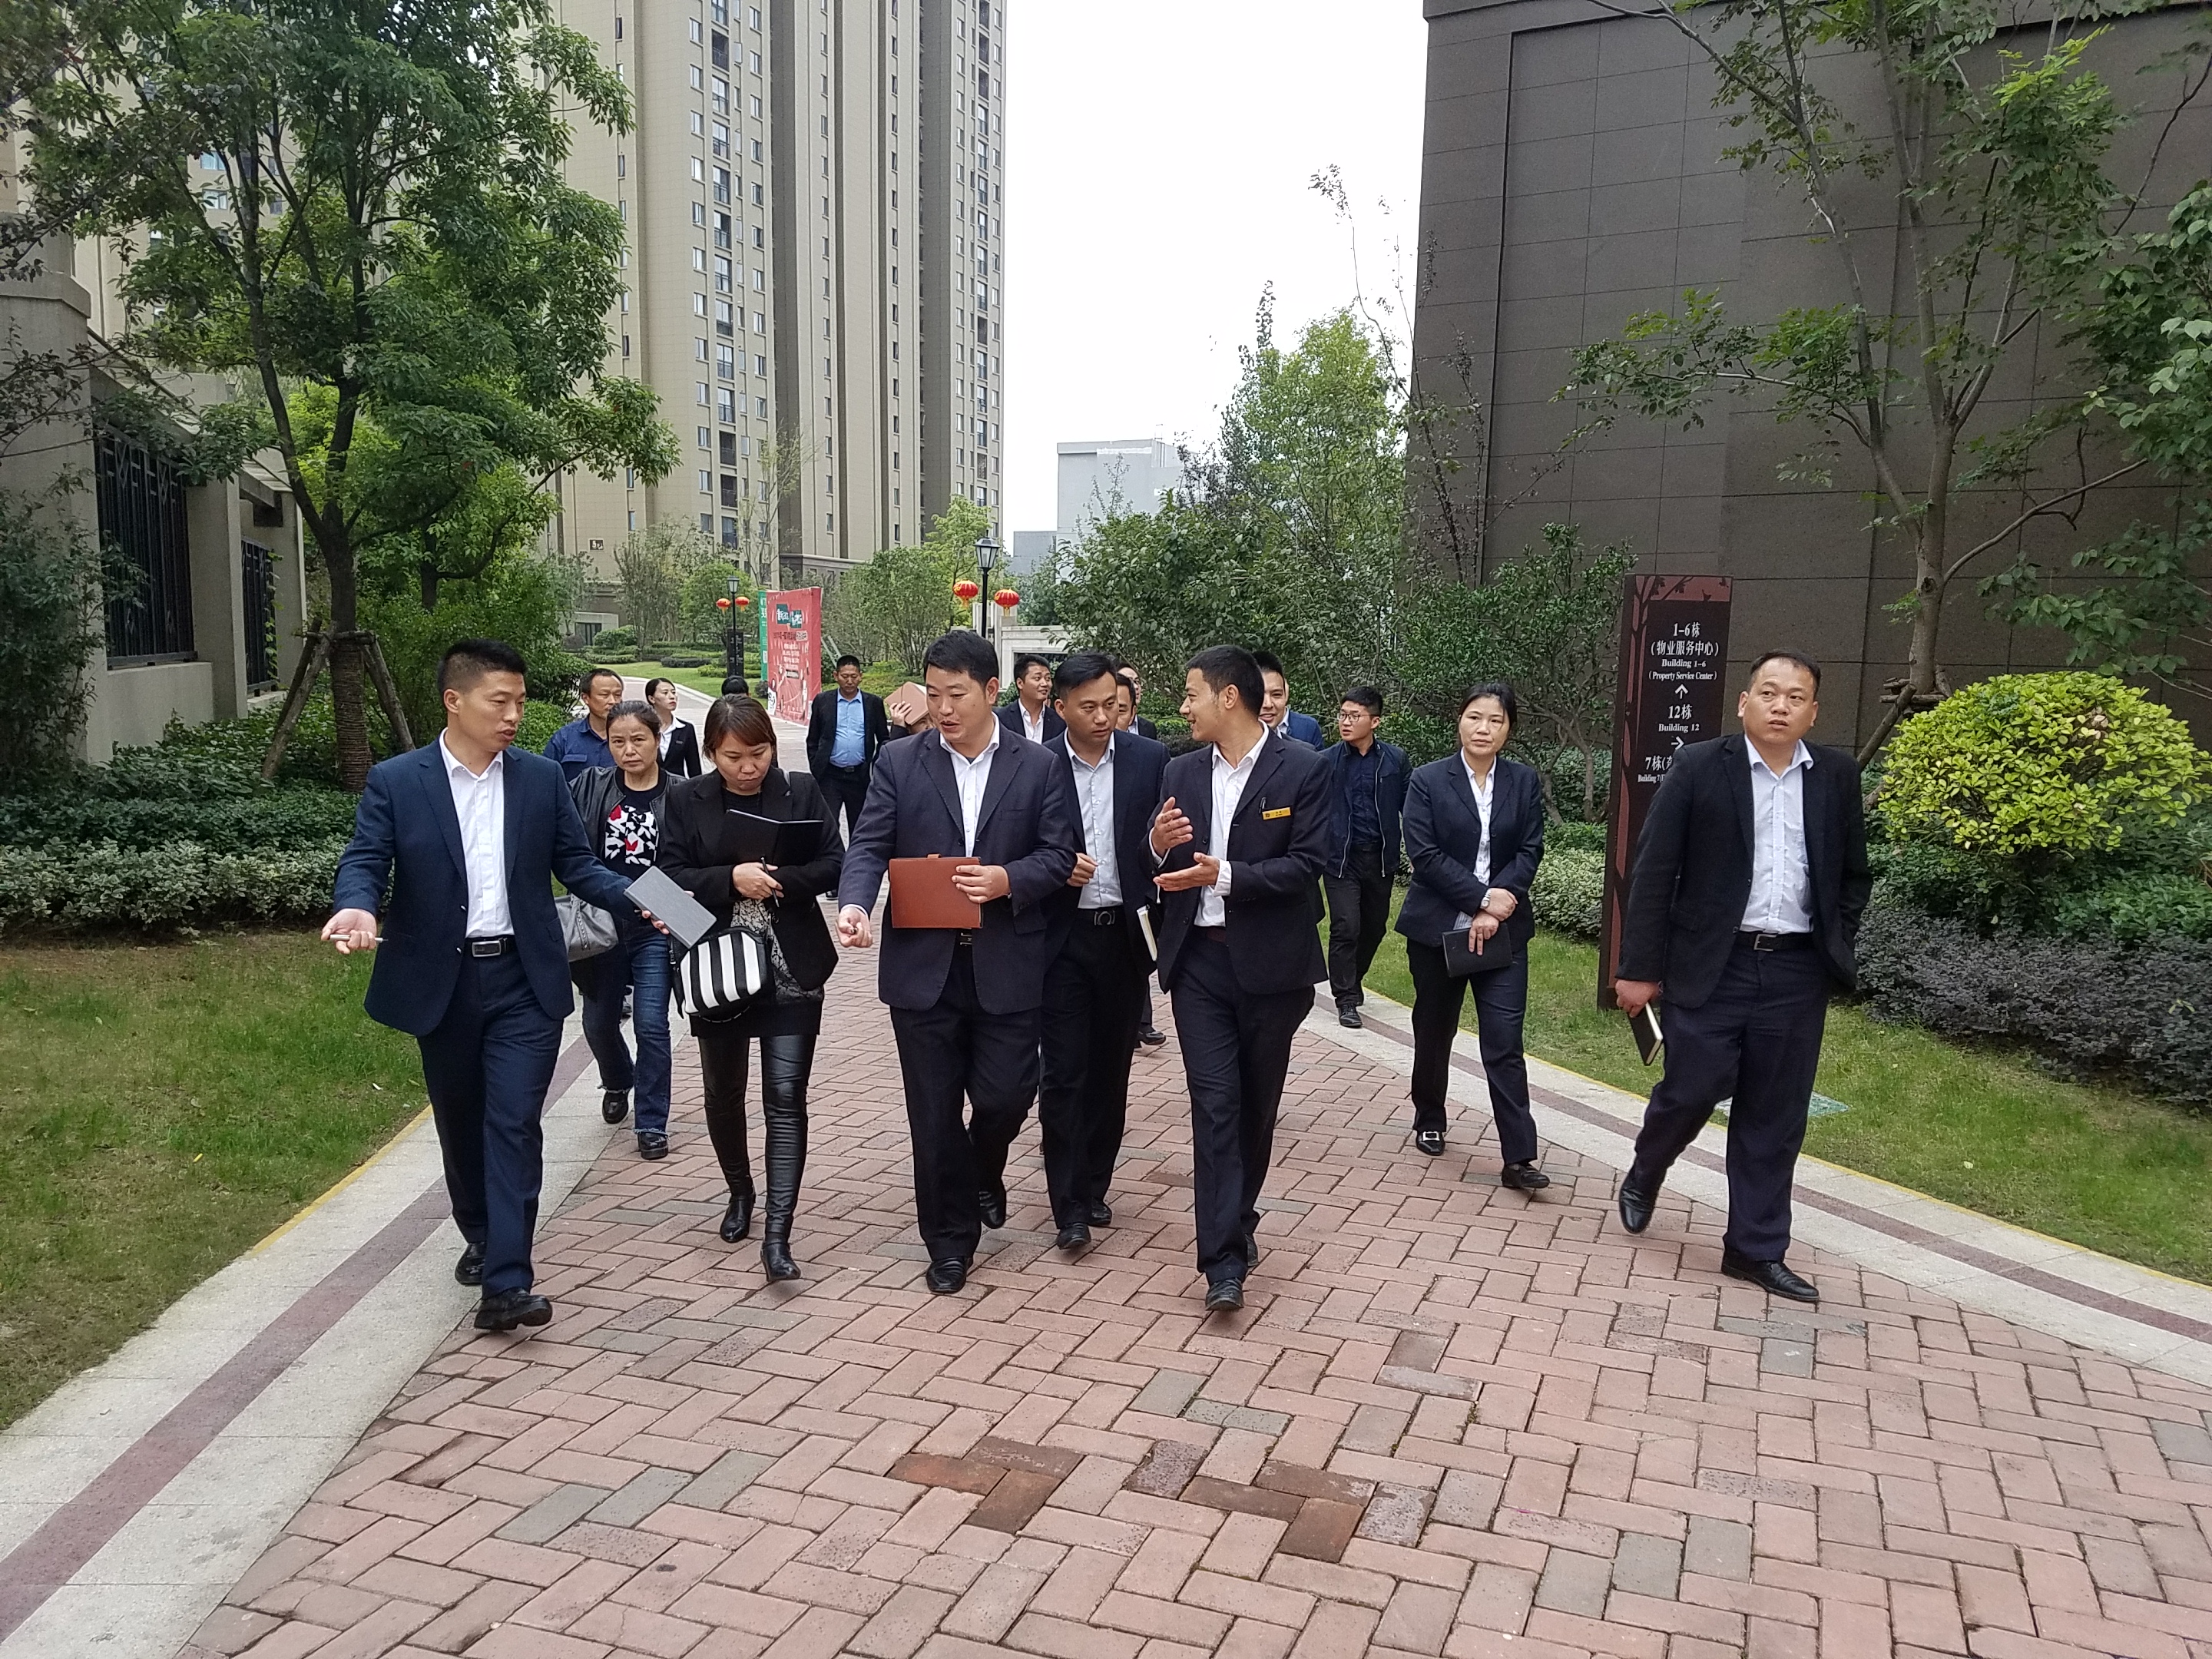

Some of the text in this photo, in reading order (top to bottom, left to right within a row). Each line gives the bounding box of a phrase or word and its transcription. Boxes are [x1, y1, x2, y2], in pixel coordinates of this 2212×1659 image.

[1673, 621, 1700, 637] 1-6栋
[1661, 658, 1692, 669] Building
[1676, 671, 1695, 680] Service
[1668, 704, 1693, 720] 12栋
[1658, 724, 1689, 733] Building
[1637, 773, 1657, 783] Building
